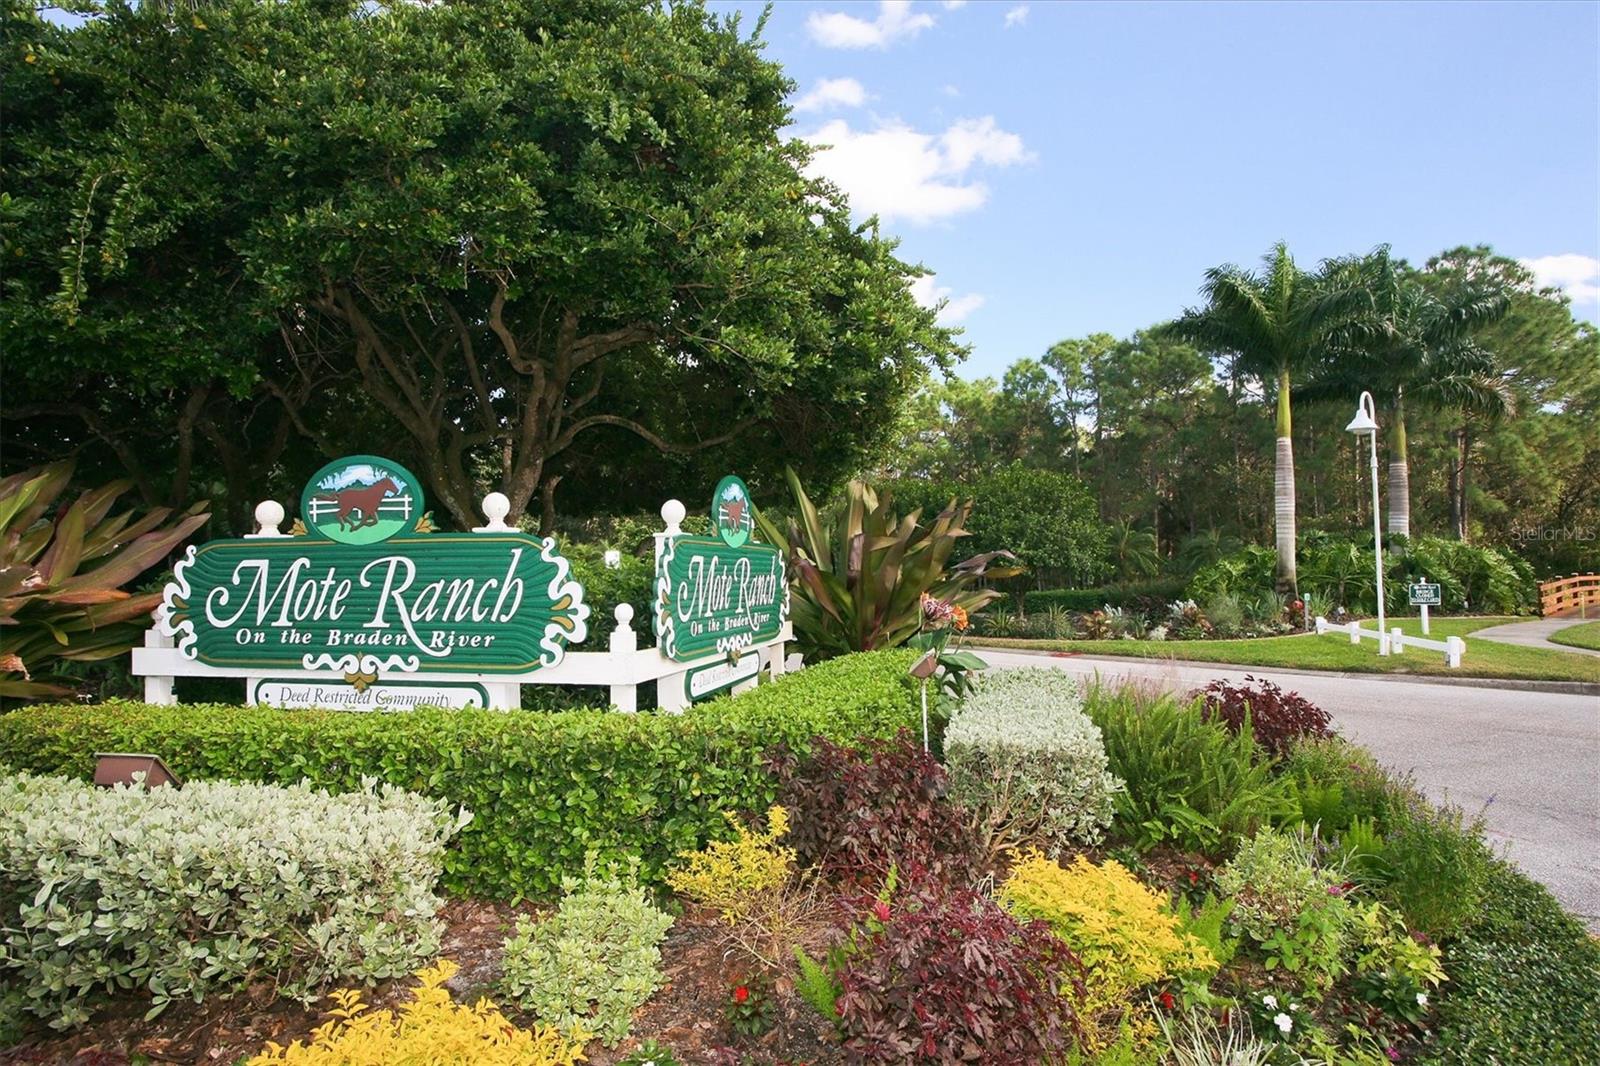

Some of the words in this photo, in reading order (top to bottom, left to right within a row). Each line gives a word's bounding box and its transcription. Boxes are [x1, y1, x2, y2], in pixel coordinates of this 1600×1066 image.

[205, 556, 352, 628] Mote
[359, 548, 524, 657] Ranch
[677, 555, 733, 622] Mote
[733, 555, 776, 631] Ranch
[690, 620, 704, 637] On
[708, 619, 721, 632] the
[724, 615, 750, 631] Braden
[752, 612, 770, 627] River
[235, 628, 266, 645] On
[280, 629, 312, 645] the
[326, 629, 409, 647] Braden
[429, 630, 496, 650] River
[280, 686, 311, 703] Deed
[314, 687, 373, 705] Restricted
[375, 689, 450, 708] Community
